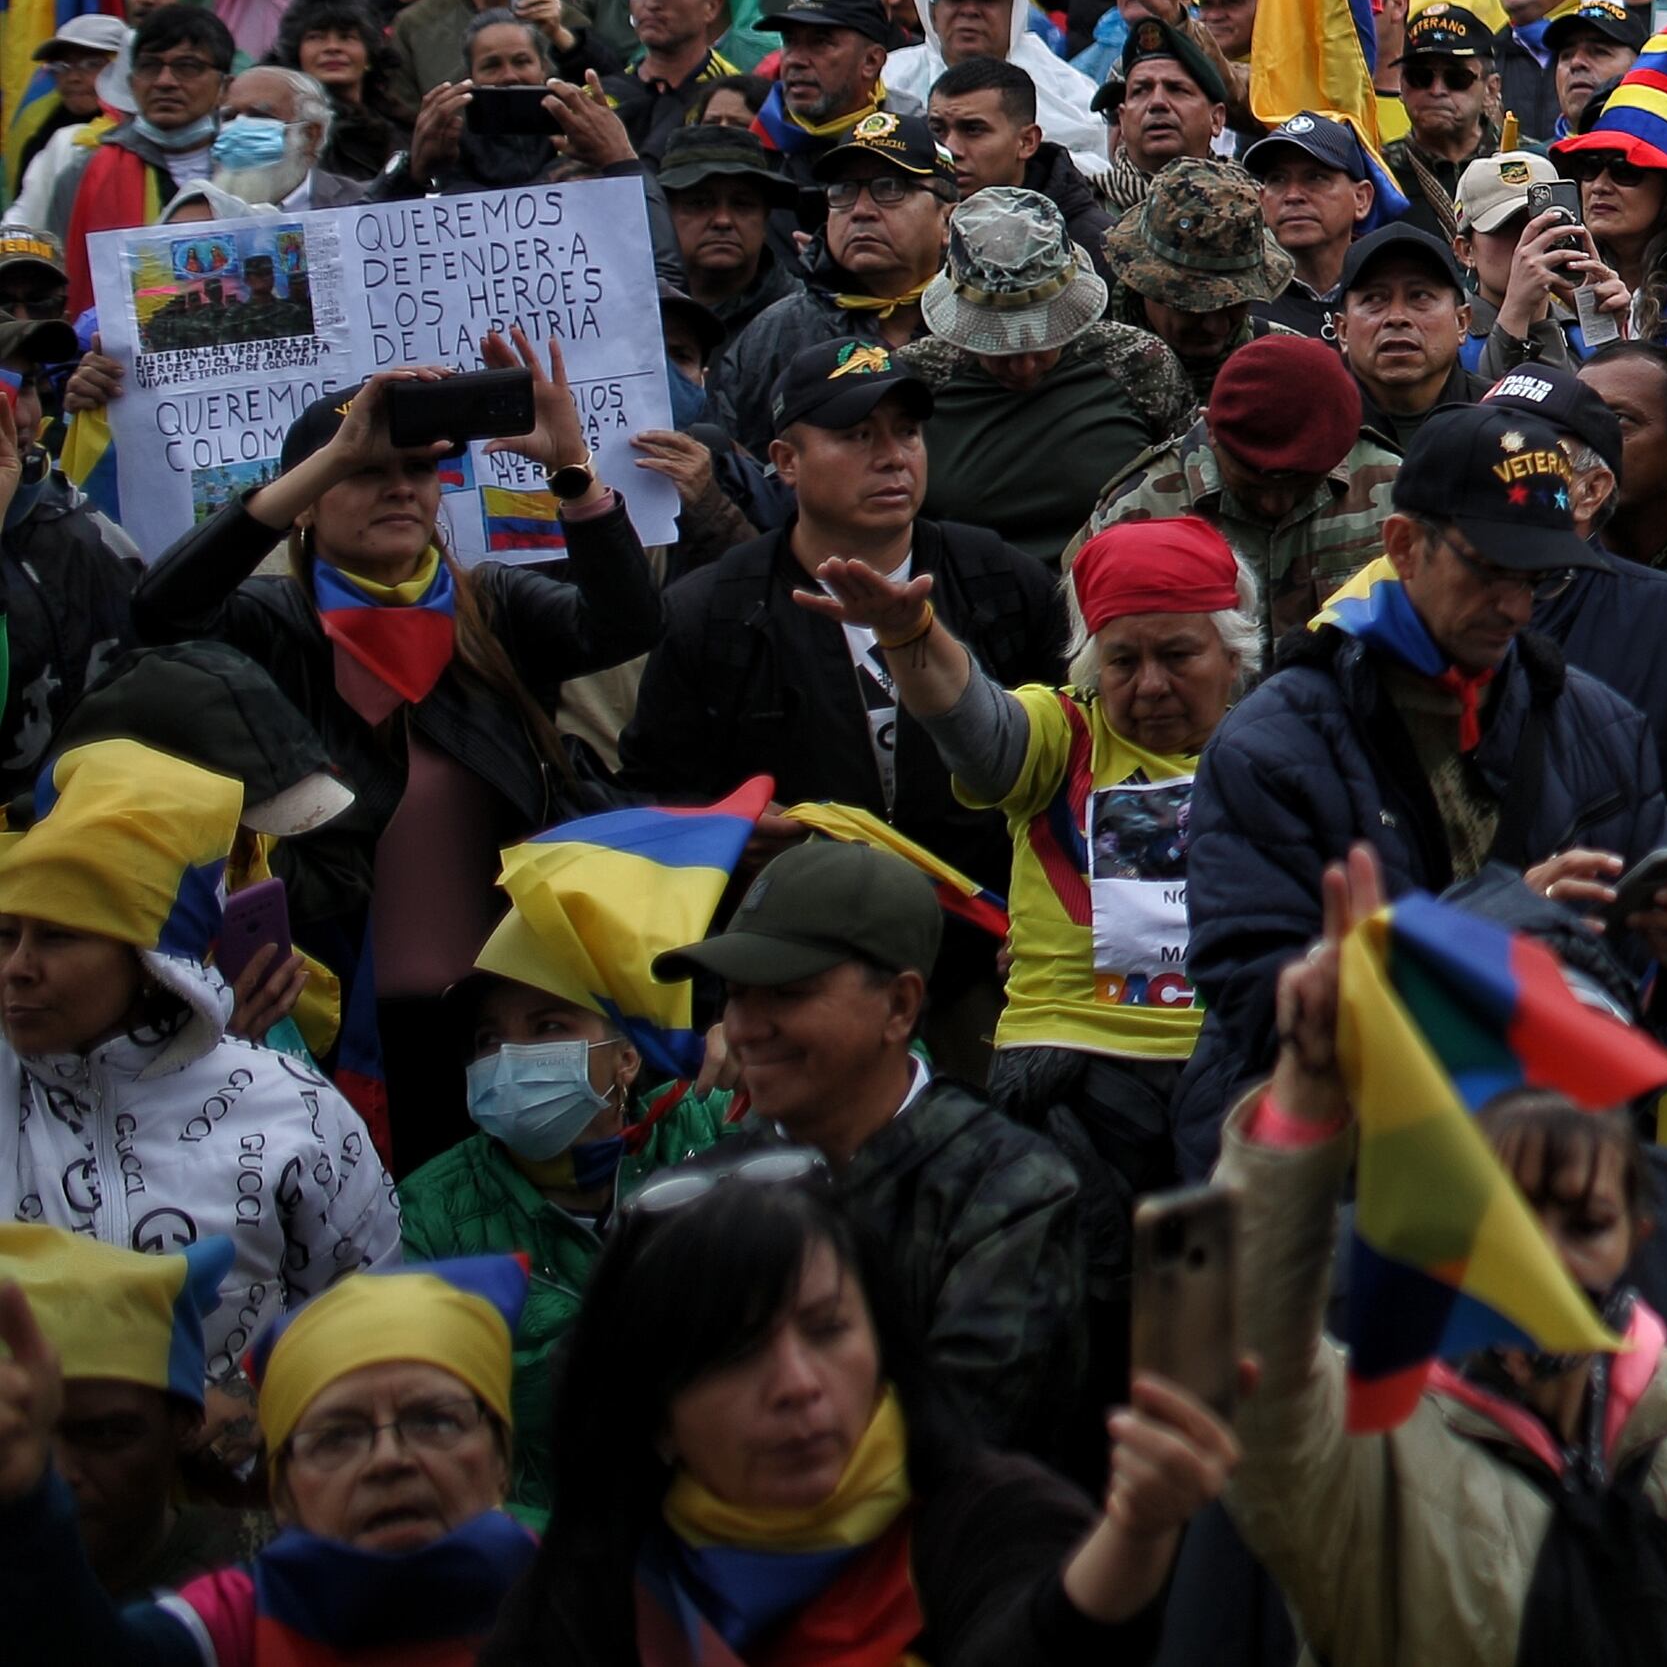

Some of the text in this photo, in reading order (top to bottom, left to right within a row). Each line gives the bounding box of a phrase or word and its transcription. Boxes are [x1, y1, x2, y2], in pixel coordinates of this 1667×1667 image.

[355, 191, 563, 253] QUEREMOS
[365, 267, 604, 330] LOS HEROES
[134, 346, 175, 366] ELLOS
[202, 343, 225, 359] LOS
[373, 329, 421, 367] DE
[439, 324, 474, 356] LA
[489, 306, 602, 346] PATRIA
[136, 357, 195, 380] HEROES
[197, 355, 233, 370] DIOS
[238, 353, 261, 365] LOS
[262, 357, 319, 372] COLOMBIA
[1535, 379, 1553, 392] TO
[572, 383, 624, 409] IOS
[1494, 383, 1551, 403] LISTEN
[163, 424, 284, 473] COLOM
[1092, 971, 1197, 1008] PAC
[178, 1068, 253, 1143] GUCCI
[114, 1112, 146, 1197] GUCCI
[235, 1132, 266, 1228] GUCCI
